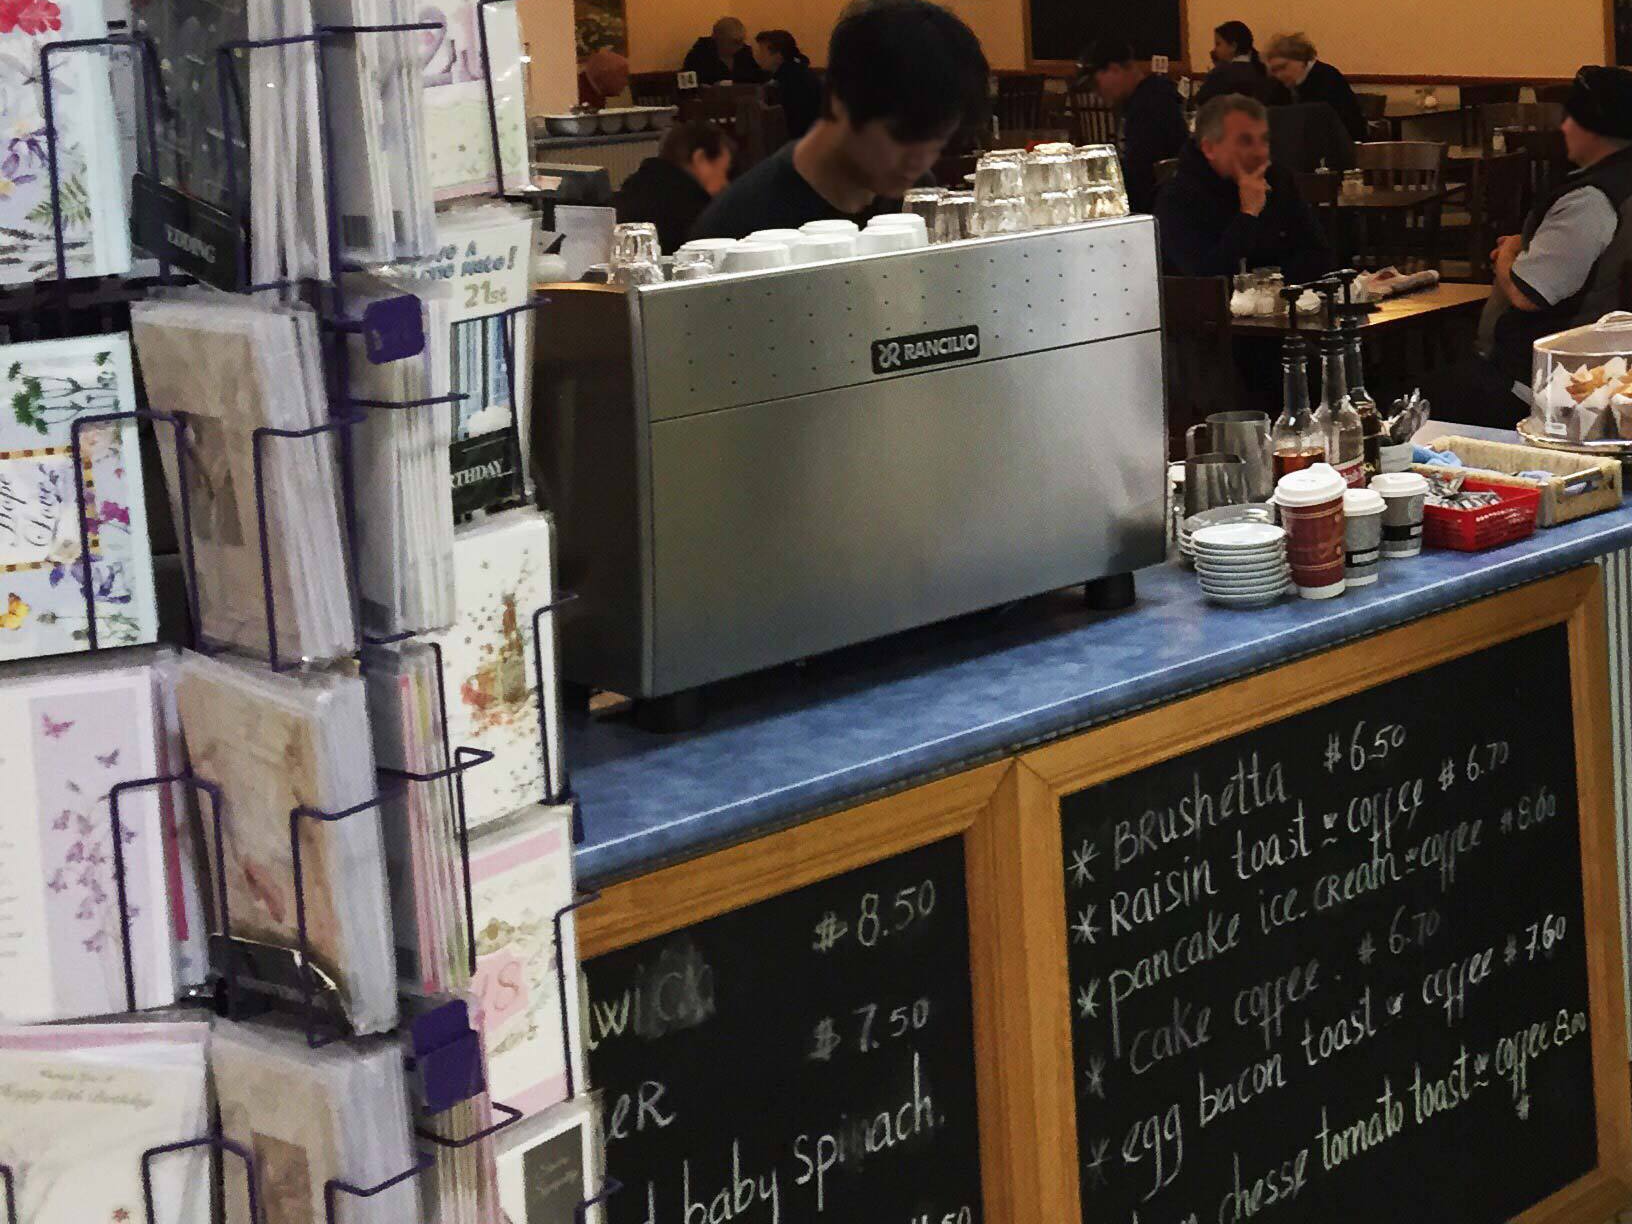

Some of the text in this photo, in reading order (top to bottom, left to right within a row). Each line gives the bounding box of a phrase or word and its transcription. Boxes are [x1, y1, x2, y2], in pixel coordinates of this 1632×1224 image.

[903, 332, 978, 361] RANCILIO
[1231, 799, 1313, 881] toast
[1259, 886, 1306, 935] ice
[1129, 996, 1213, 1075] cake
[1234, 958, 1320, 1051] coffee
[1121, 1103, 1184, 1203] egg
[1199, 1054, 1288, 1127] bacon
[1300, 984, 1377, 1065] toast
[1314, 1077, 1404, 1171] tomato
[1408, 1044, 1470, 1124] toast
